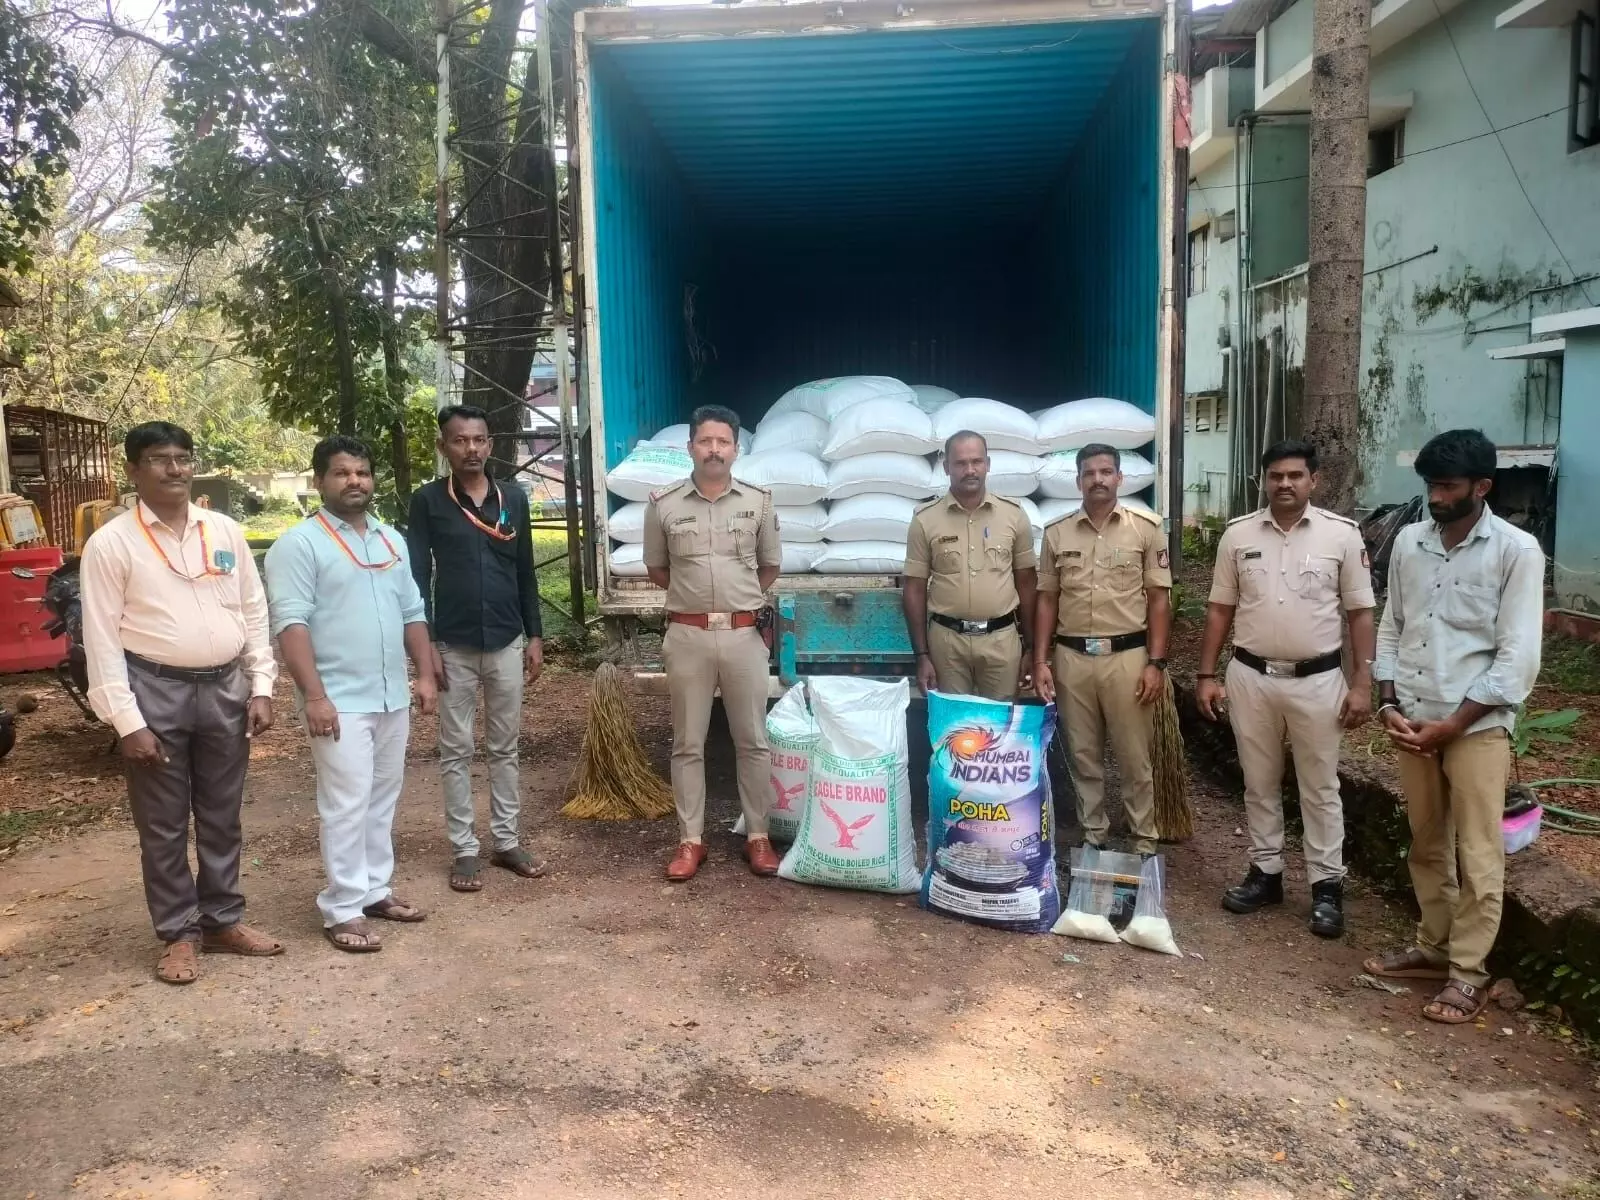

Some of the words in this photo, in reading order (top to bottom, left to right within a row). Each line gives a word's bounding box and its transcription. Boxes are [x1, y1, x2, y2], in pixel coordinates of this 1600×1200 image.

[973, 750, 1030, 764] MUMBAI
[839, 768, 876, 778] QUALITY
[949, 762, 1031, 785] INDIANS
[815, 780, 843, 800] EAGLE
[845, 785, 887, 804] BRAND
[950, 798, 1010, 821] POHA
[1041, 800, 1049, 841] POHA
[847, 859, 870, 868] BOILED
[872, 856, 886, 866] RICE
